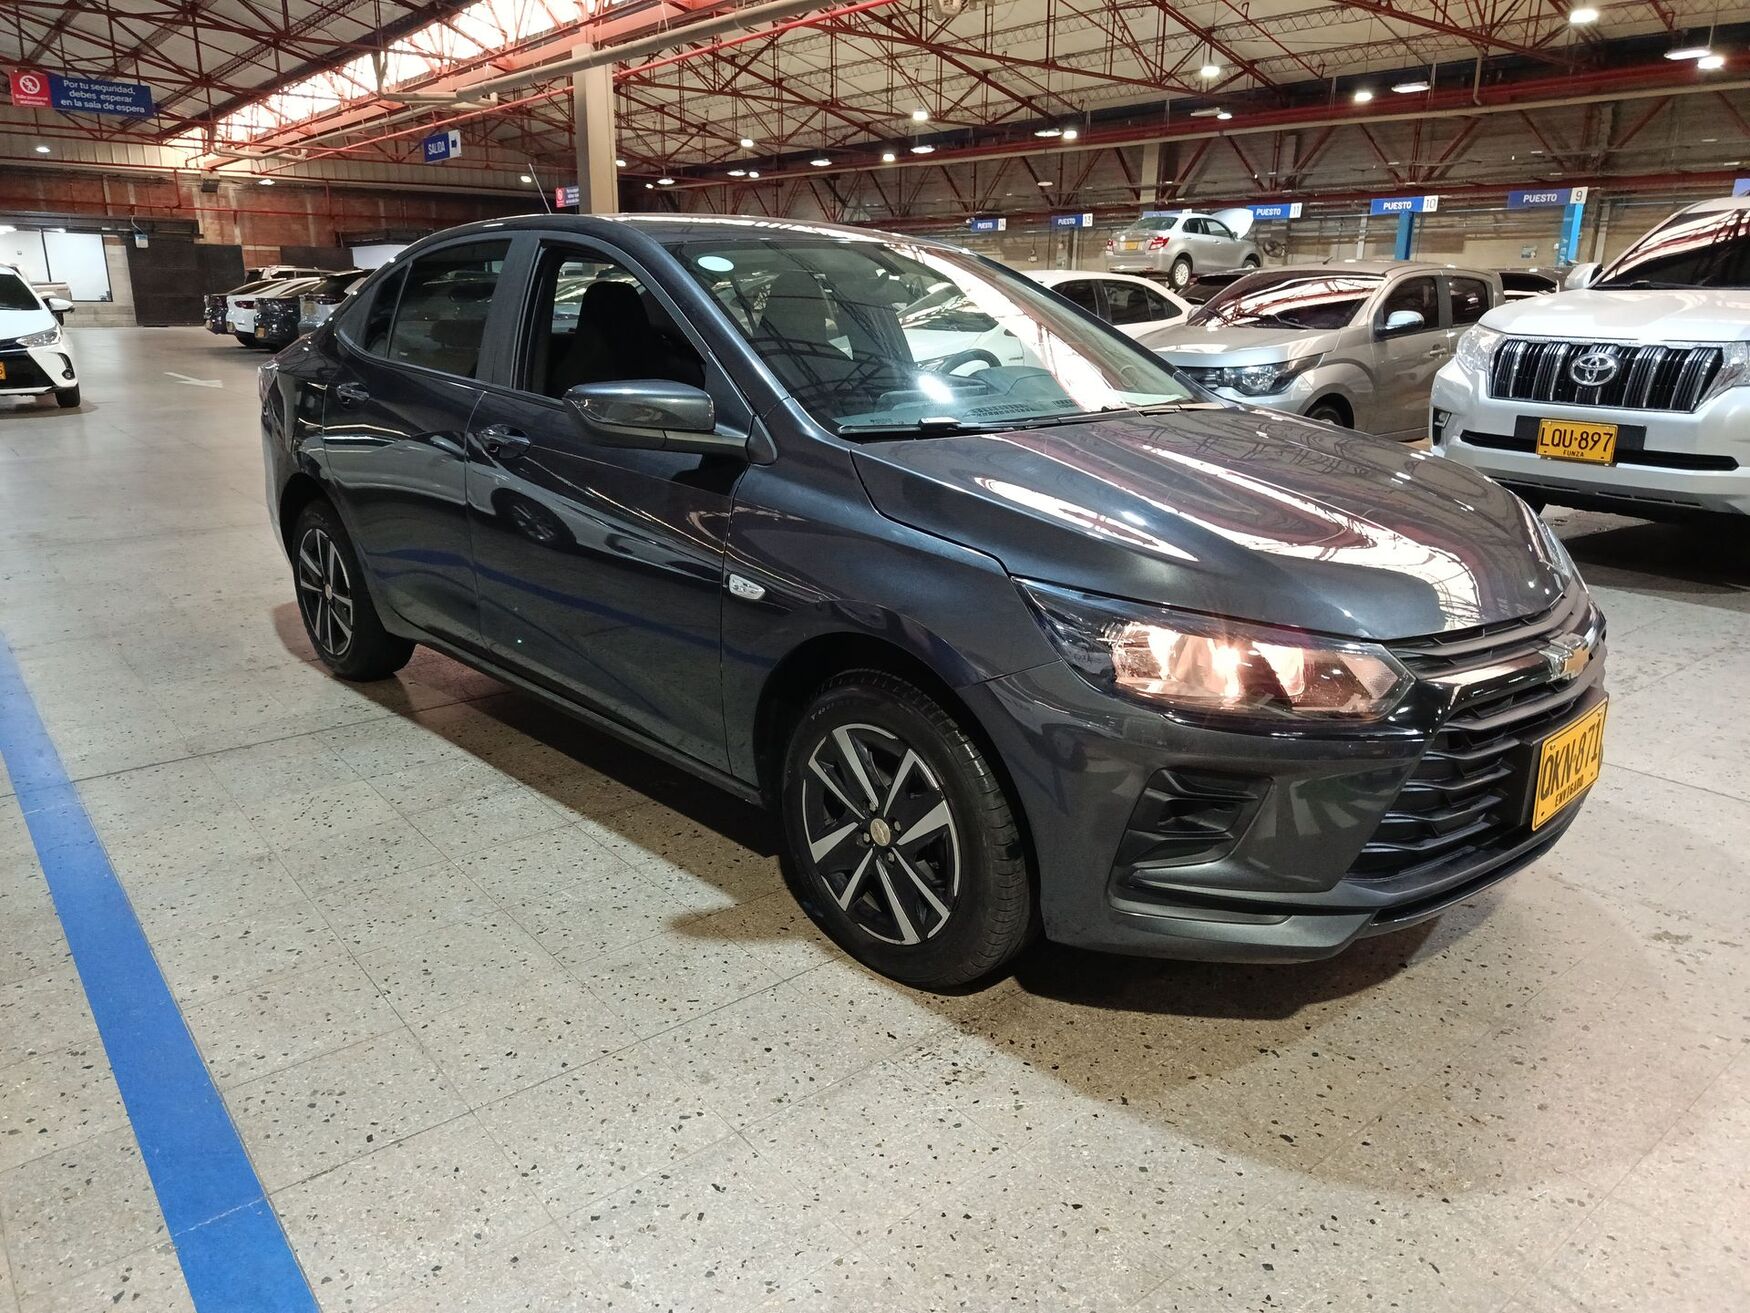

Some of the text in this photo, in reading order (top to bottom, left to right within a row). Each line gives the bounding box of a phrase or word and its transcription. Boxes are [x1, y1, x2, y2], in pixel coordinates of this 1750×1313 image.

[63, 80, 136, 95] Por tu seguridad,
[69, 90, 133, 103] debes esperar
[74, 99, 83, 107] la
[84, 100, 101, 109] sala
[103, 101, 115, 110] de
[116, 104, 146, 114] espera
[428, 140, 446, 156] SALIDA
[1523, 190, 1583, 203] PUESTO 9
[1383, 198, 1436, 210] PUESTO 10
[1255, 207, 1282, 216] PUESTO
[977, 221, 993, 230] PUESTO
[1057, 217, 1076, 226] PUESTO
[1562, 449, 1585, 457] FUNZA
